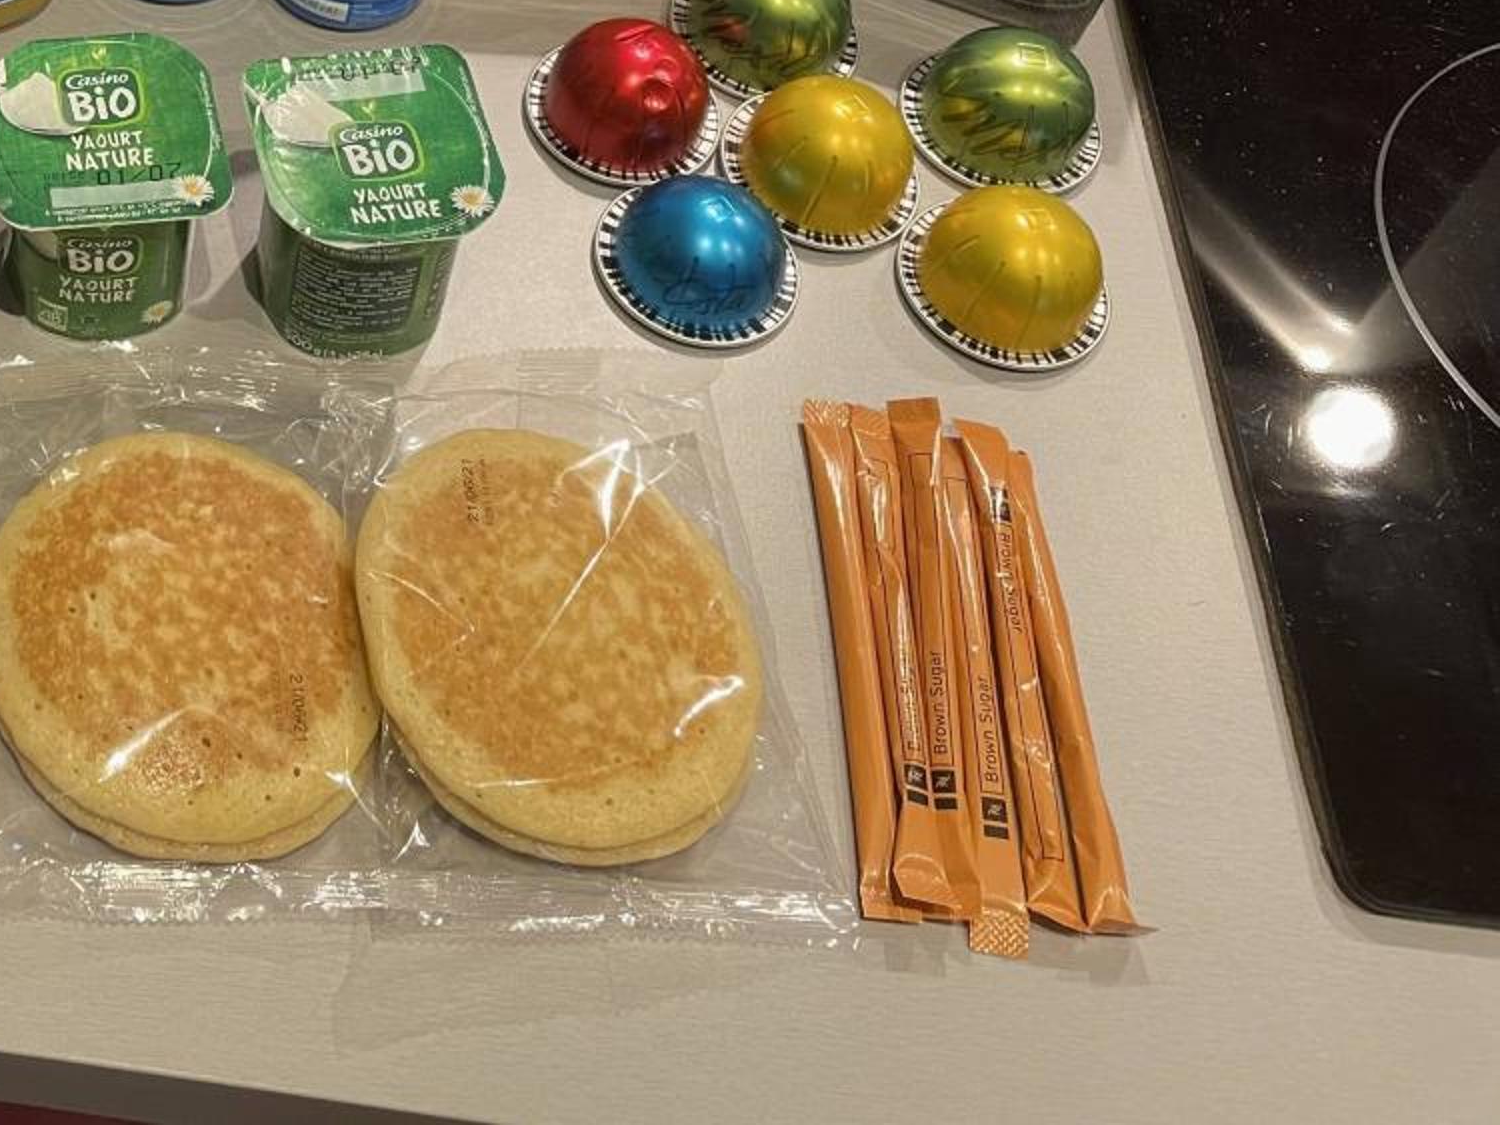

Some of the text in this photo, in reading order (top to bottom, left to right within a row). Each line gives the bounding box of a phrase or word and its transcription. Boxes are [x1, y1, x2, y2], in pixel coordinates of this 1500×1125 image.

[65, 72, 129, 90] Casino
[71, 130, 143, 150] YAOURT
[339, 125, 403, 144] Casino
[65, 147, 154, 172] NATURE
[97, 162, 181, 186] 01/07
[353, 182, 429, 204] YAOURT
[350, 199, 443, 225] NATURE
[59, 275, 140, 292] YAOURT
[59, 288, 137, 304] NATURE
[930, 651, 948, 755] Brown Sugar
[978, 677, 999, 783] Brown Sugar
